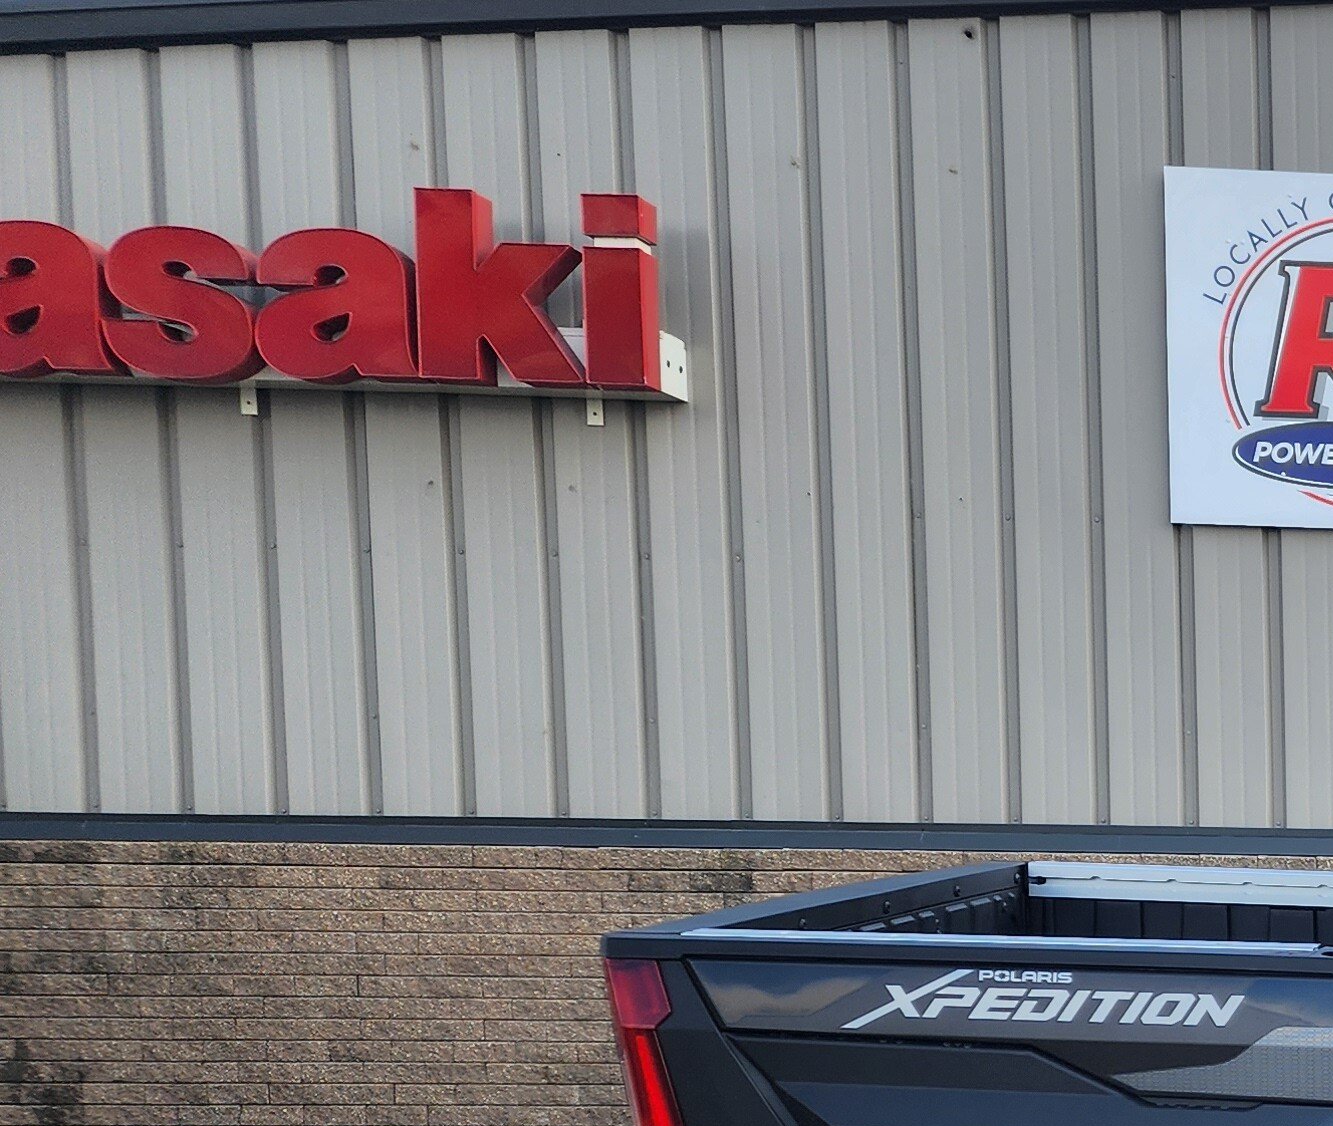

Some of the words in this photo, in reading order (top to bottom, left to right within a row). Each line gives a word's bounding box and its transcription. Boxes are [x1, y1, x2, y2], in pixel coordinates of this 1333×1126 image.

[1202, 197, 1311, 304] LOCALLY
[840, 968, 1246, 1030] XPEDITION
[978, 970, 1073, 984] POLARIS
